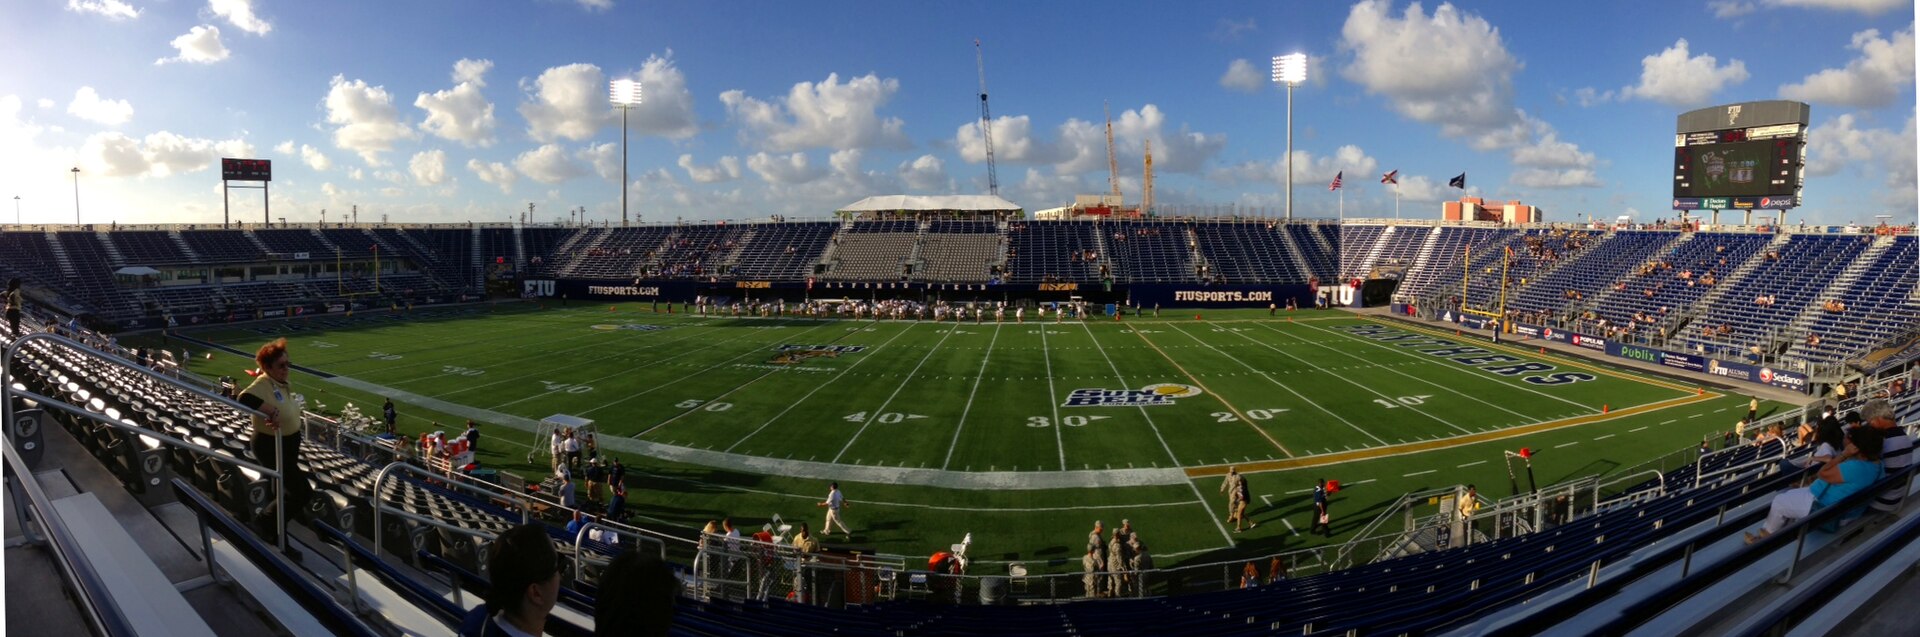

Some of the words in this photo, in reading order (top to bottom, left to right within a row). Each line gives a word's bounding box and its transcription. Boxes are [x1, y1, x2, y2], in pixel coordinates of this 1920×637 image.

[1770, 199, 1791, 207] pepsi
[523, 279, 556, 296] FIU
[588, 285, 660, 296] FIUSPORTS.COM
[1580, 336, 1604, 345] POPULAR
[1621, 346, 1655, 361] Publix
[1714, 366, 1728, 376] FIU
[1728, 369, 1749, 377] ALUMNI
[1064, 394, 1174, 406] BELT
[1373, 396, 1425, 409] 10
[843, 411, 905, 424] 40
[1026, 416, 1088, 427] 30
[1210, 409, 1275, 423] 20
